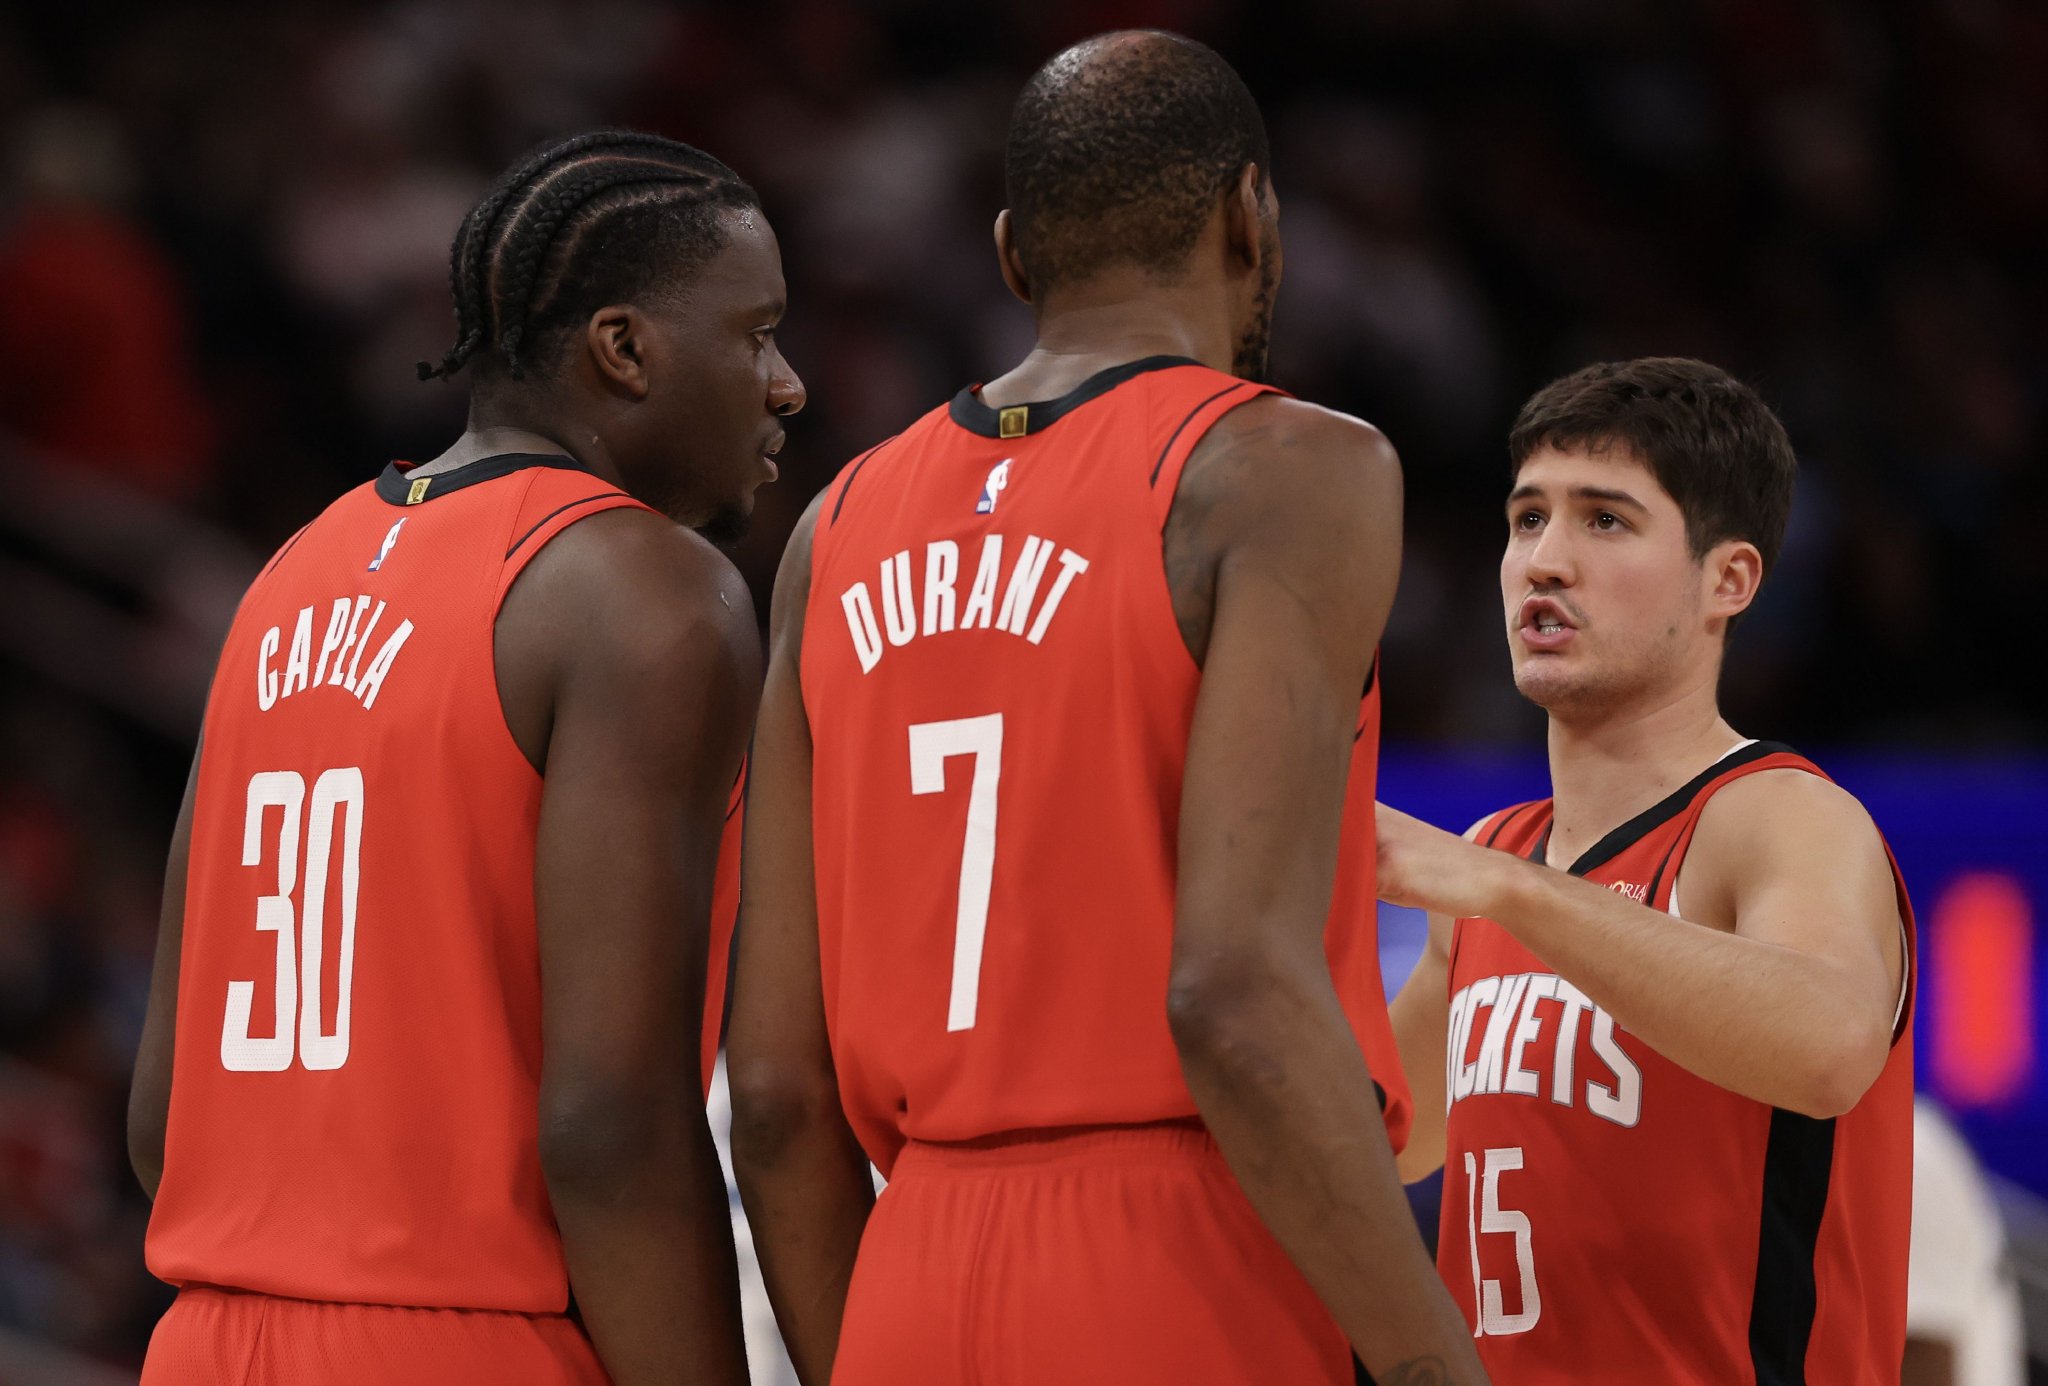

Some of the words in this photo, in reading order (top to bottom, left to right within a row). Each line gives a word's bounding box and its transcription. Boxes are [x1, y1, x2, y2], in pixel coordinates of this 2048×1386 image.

[257, 594, 415, 711] CAPELA
[841, 533, 1090, 675] DURANT
[220, 766, 365, 1073] 30
[908, 712, 1004, 1033] 7
[1446, 972, 1643, 1129] OCKETS
[1464, 1147, 1542, 1339] 15
